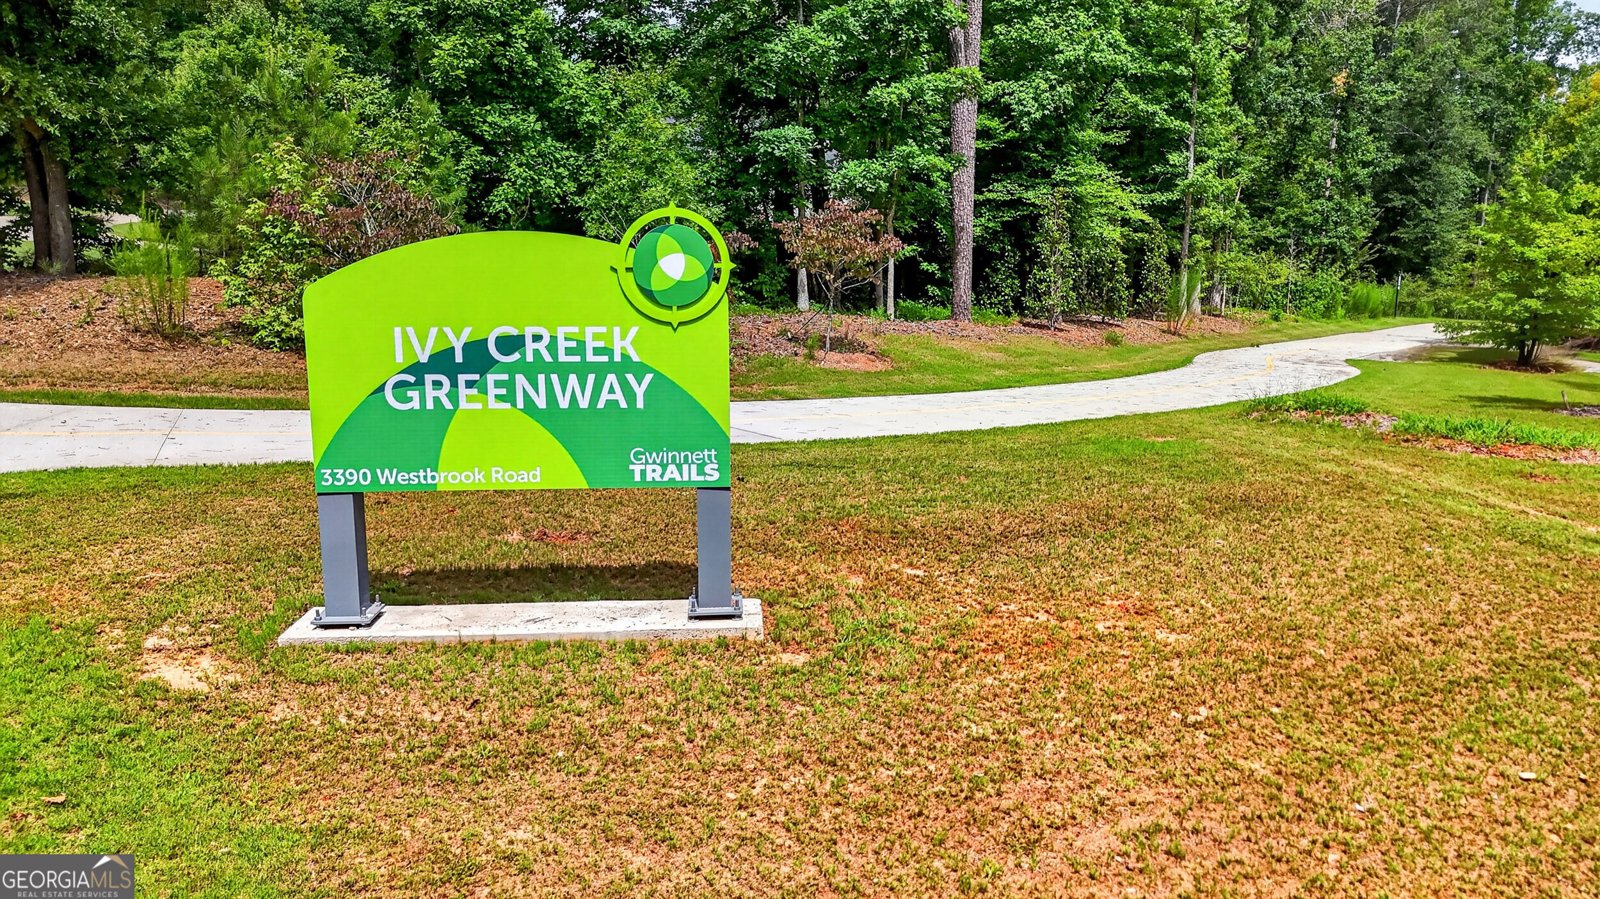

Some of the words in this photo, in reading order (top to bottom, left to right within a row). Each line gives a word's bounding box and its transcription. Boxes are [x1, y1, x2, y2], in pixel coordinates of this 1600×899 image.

[393, 326, 472, 364] IVY
[487, 325, 641, 363] CREEK
[384, 372, 655, 411] GREENWAY
[629, 447, 718, 465] Gwinnett
[320, 468, 372, 486] 3390
[375, 466, 487, 486] Westbrook
[491, 466, 541, 484] Road
[629, 463, 720, 482] TRAILS
